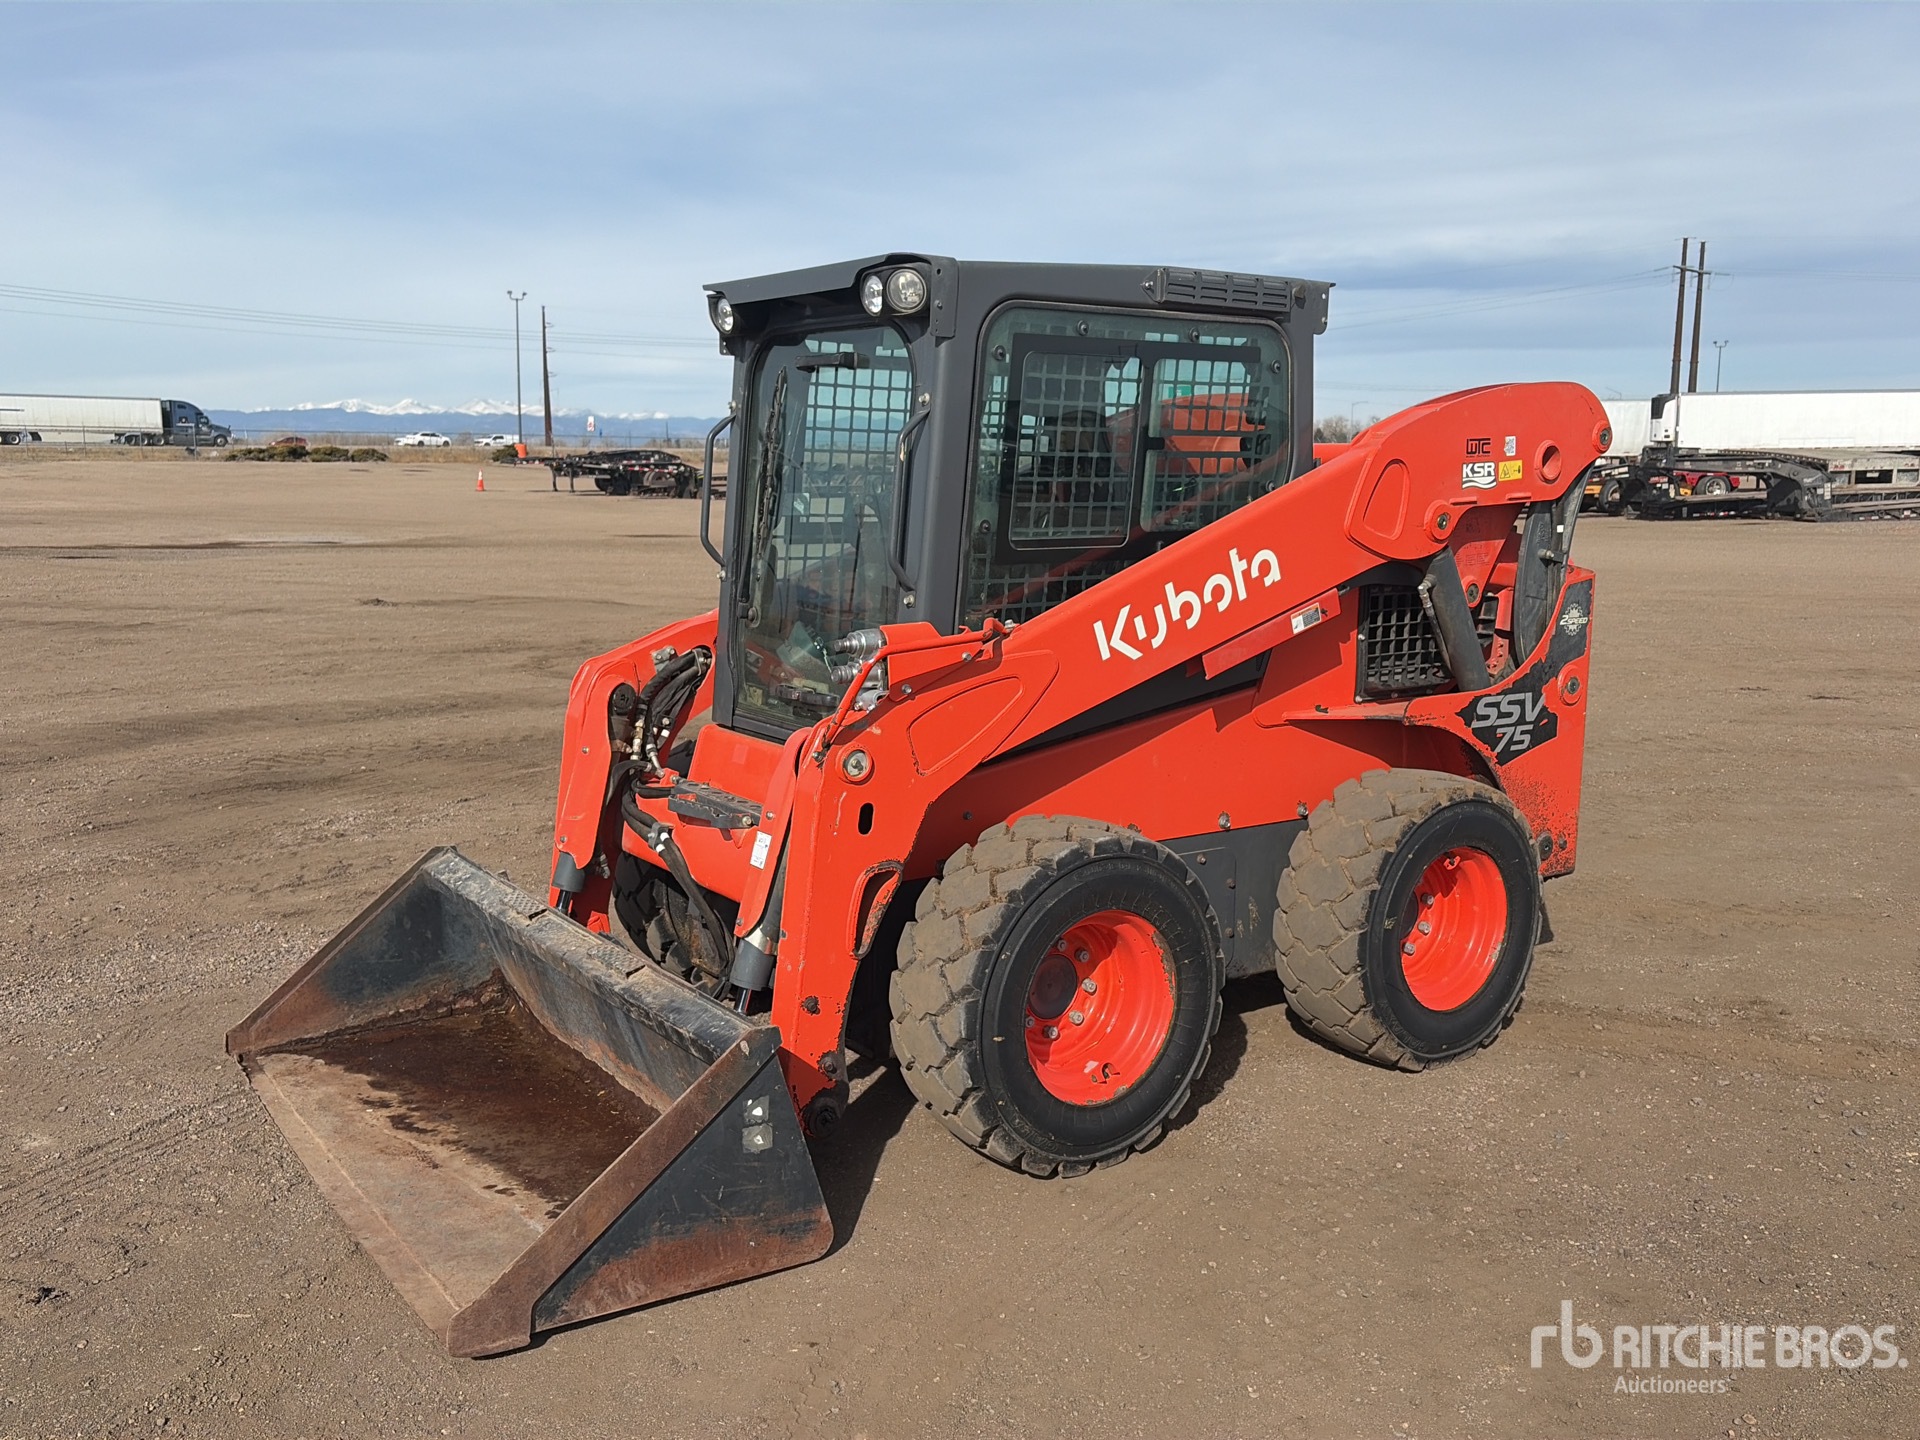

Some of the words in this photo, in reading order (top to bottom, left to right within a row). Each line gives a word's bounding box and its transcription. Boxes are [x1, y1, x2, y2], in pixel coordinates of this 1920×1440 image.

[1462, 462, 1496, 478] KSR
[1093, 548, 1281, 661] Kubota
[1471, 692, 1545, 729] SSV
[1494, 724, 1535, 753] 75
